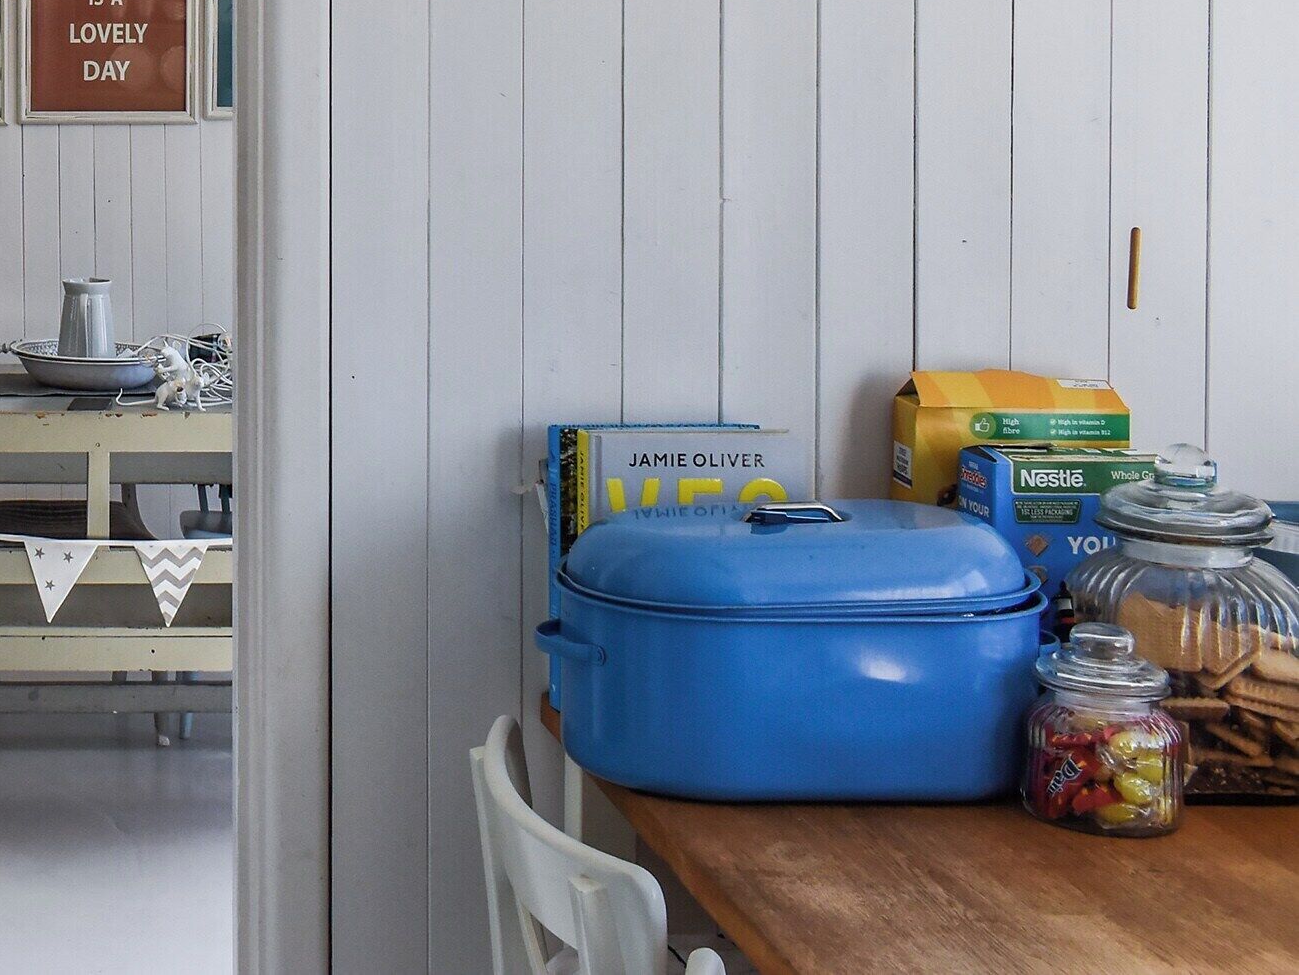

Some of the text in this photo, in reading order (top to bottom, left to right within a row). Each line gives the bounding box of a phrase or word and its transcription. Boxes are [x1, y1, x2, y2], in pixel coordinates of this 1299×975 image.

[69, 22, 148, 45] LOVELY
[82, 60, 131, 82] DAY
[1002, 417, 1020, 427] High
[1002, 427, 1021, 435] fibre
[629, 452, 765, 468] JAMIE OLIVER
[1110, 470, 1140, 480] Whole
[968, 499, 990, 518] YOUR
